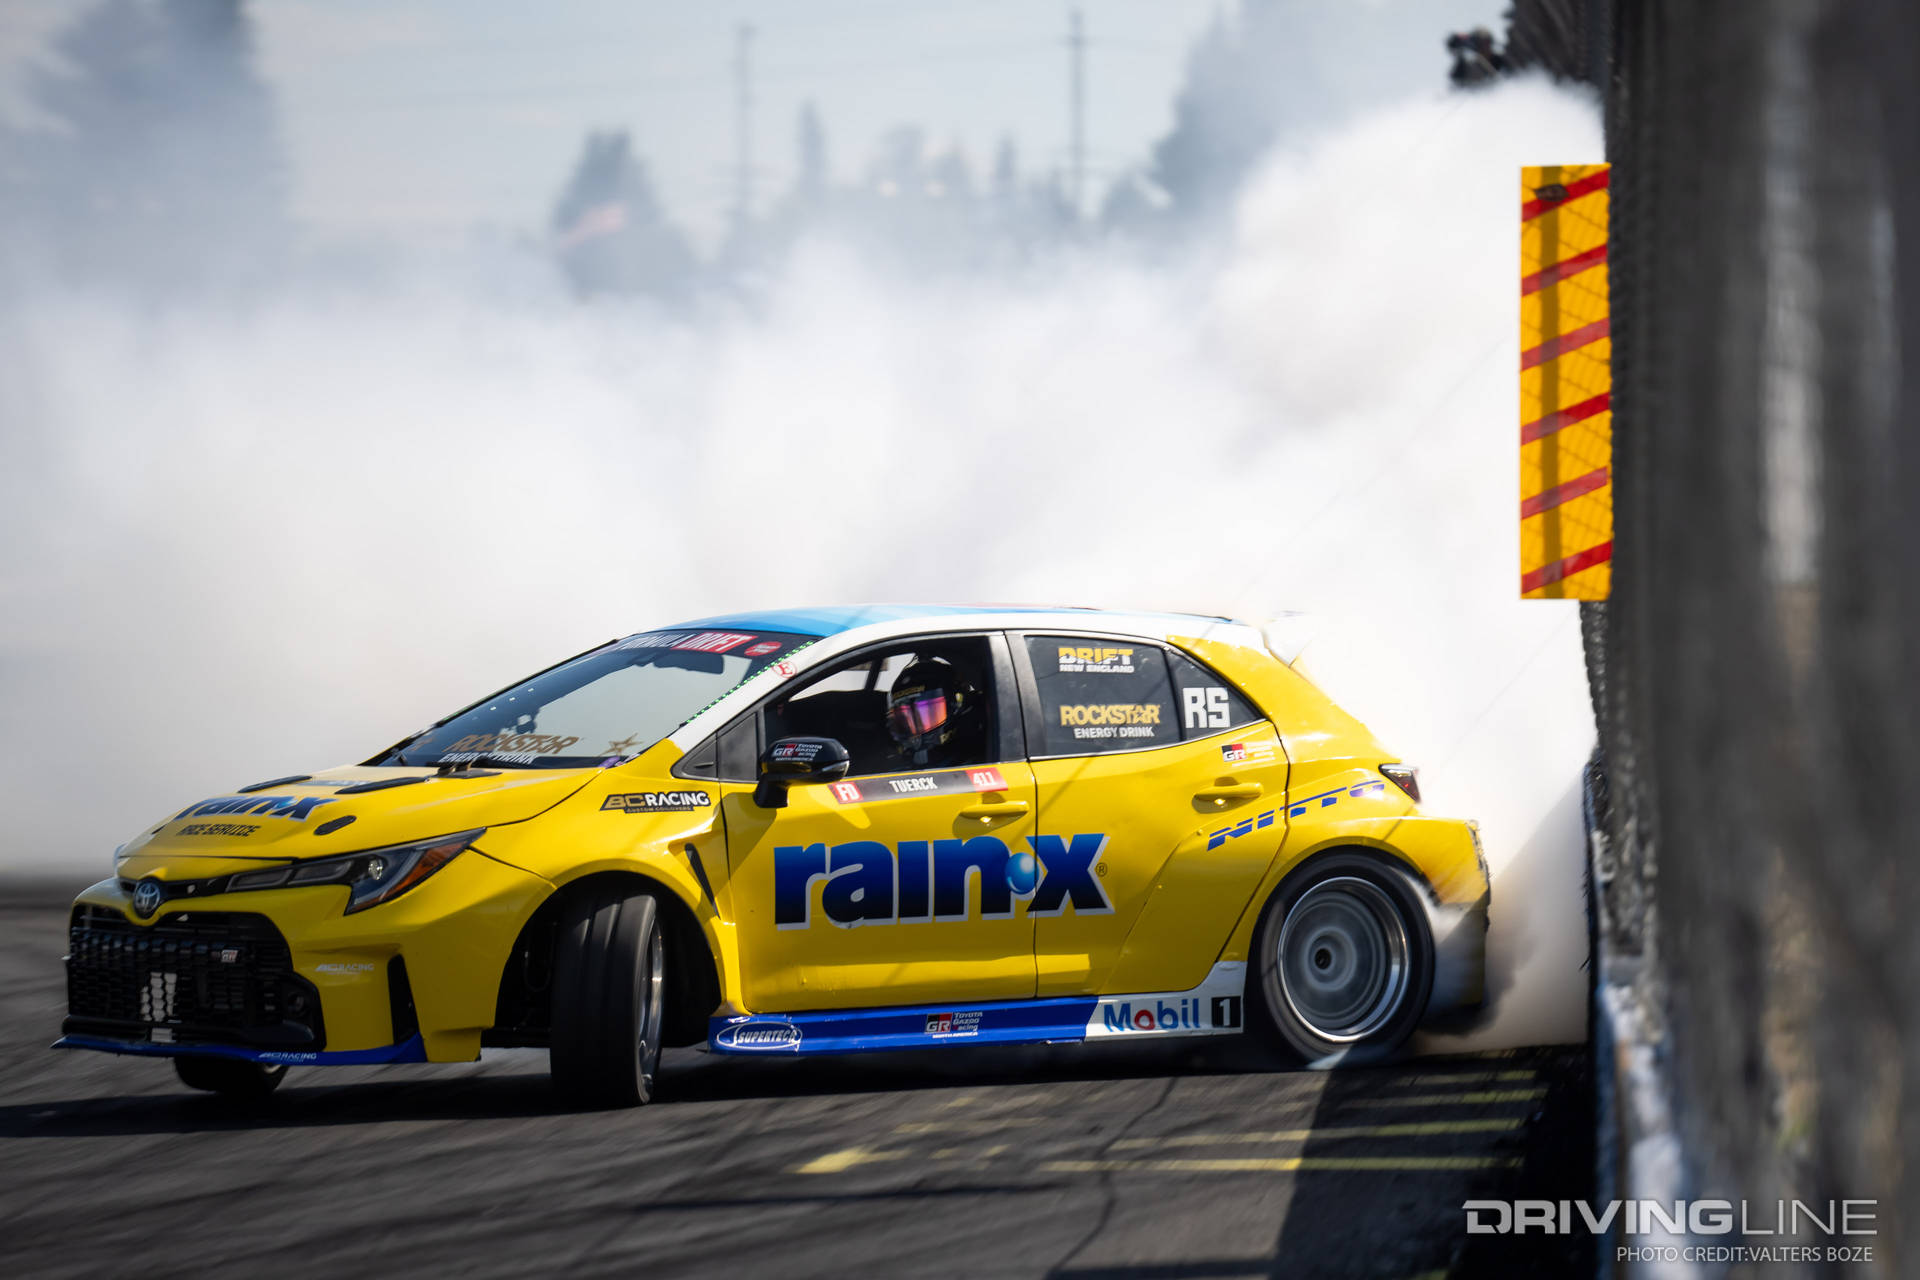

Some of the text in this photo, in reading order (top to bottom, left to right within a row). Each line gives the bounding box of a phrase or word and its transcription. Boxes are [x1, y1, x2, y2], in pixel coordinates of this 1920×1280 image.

[676, 632, 753, 652] DRIFT
[1058, 648, 1133, 665] DRIFT
[1059, 664, 1134, 673] NEW ENGLAND
[1060, 704, 1160, 726] ROCKSTAR
[1183, 687, 1230, 728] RS
[1073, 726, 1154, 738] ENERGY DRINK
[442, 733, 579, 754] ROCKSTAR
[889, 776, 938, 793] TUERCK
[973, 771, 997, 786] 411
[836, 783, 859, 800] FD
[1104, 998, 1231, 1032] Mobil 1
